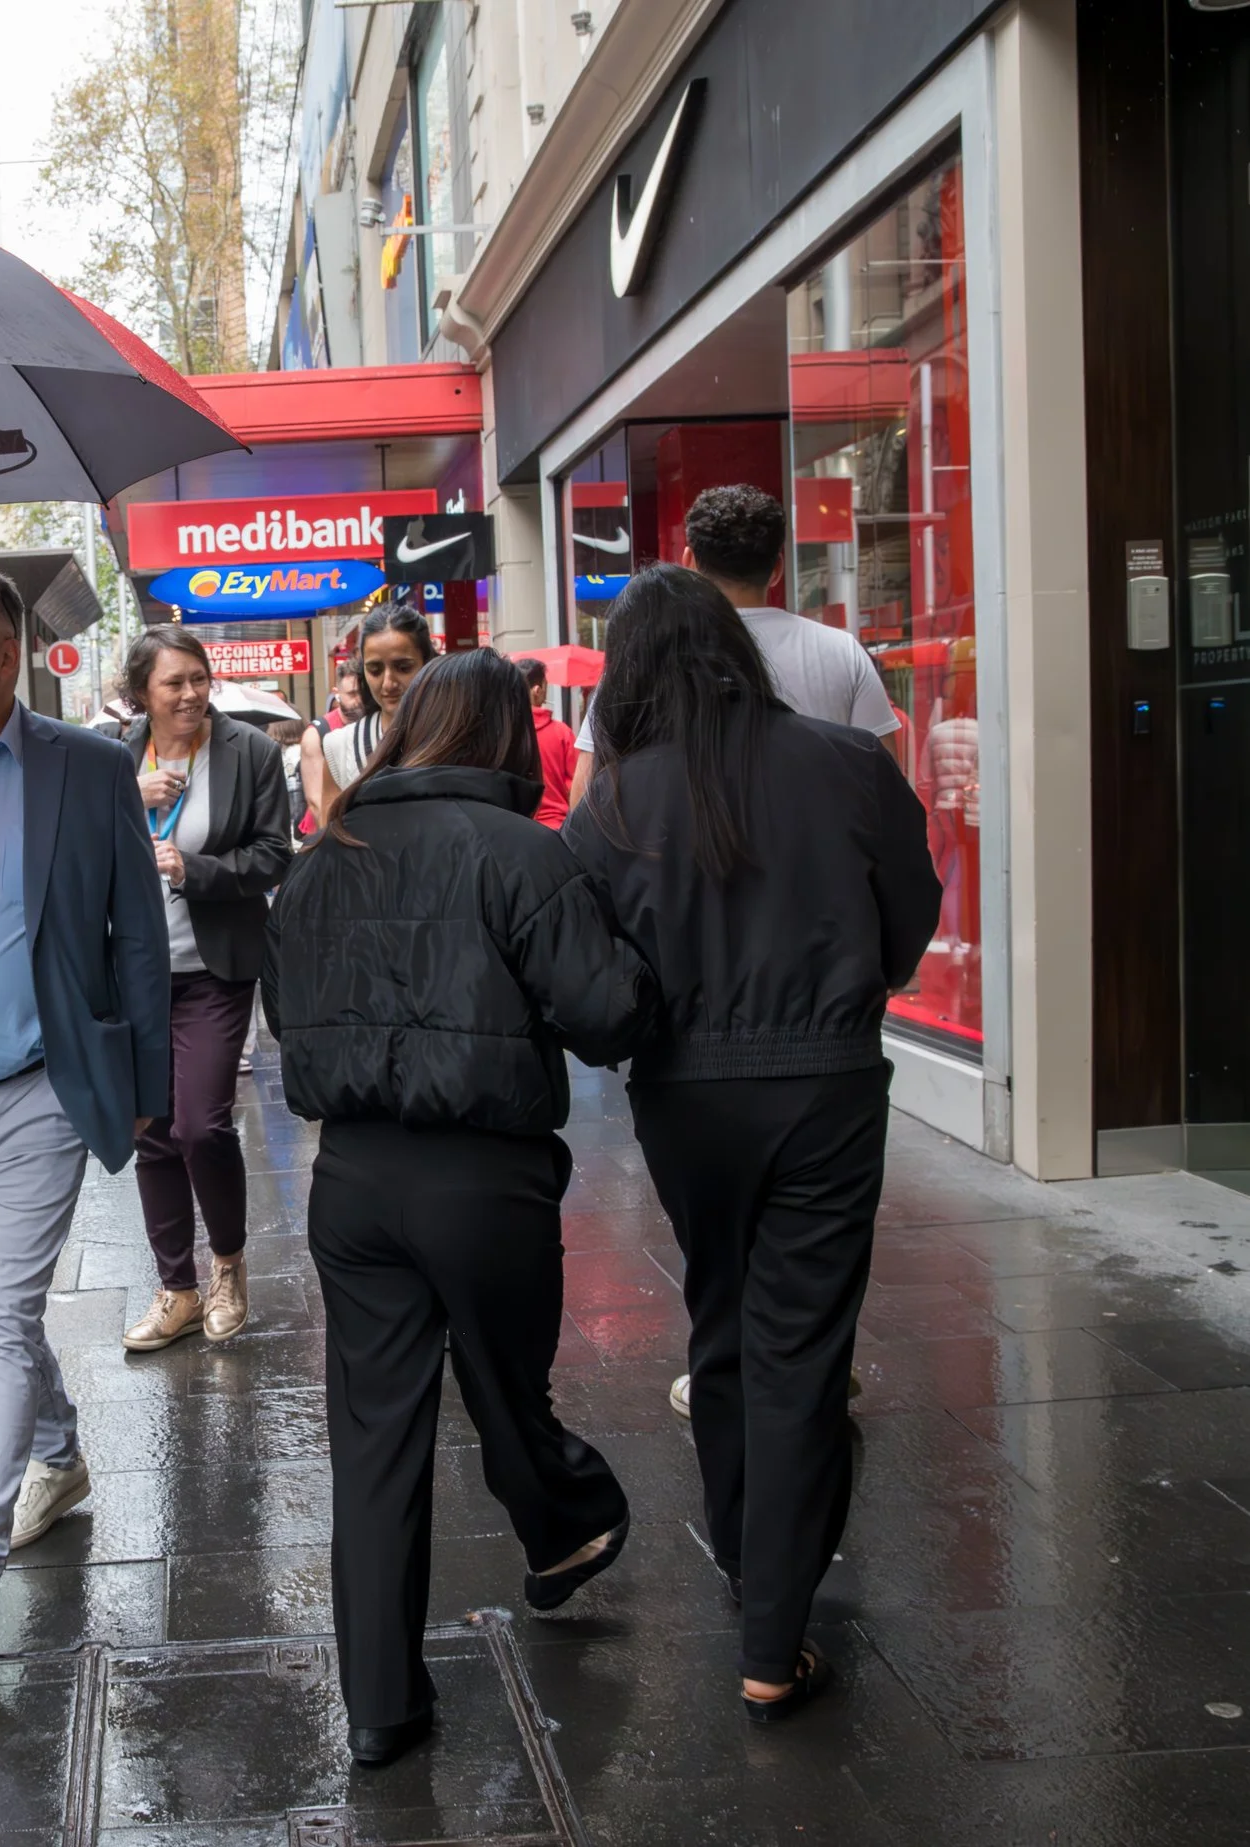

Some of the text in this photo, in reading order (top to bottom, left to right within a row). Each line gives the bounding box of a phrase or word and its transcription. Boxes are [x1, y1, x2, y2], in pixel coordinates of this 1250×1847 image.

[178, 506, 384, 554] medibank
[221, 567, 342, 599] EzyMart
[58, 648, 72, 669] L
[204, 643, 293, 660] ACCONIST &
[210, 656, 294, 674] VENIENCE
